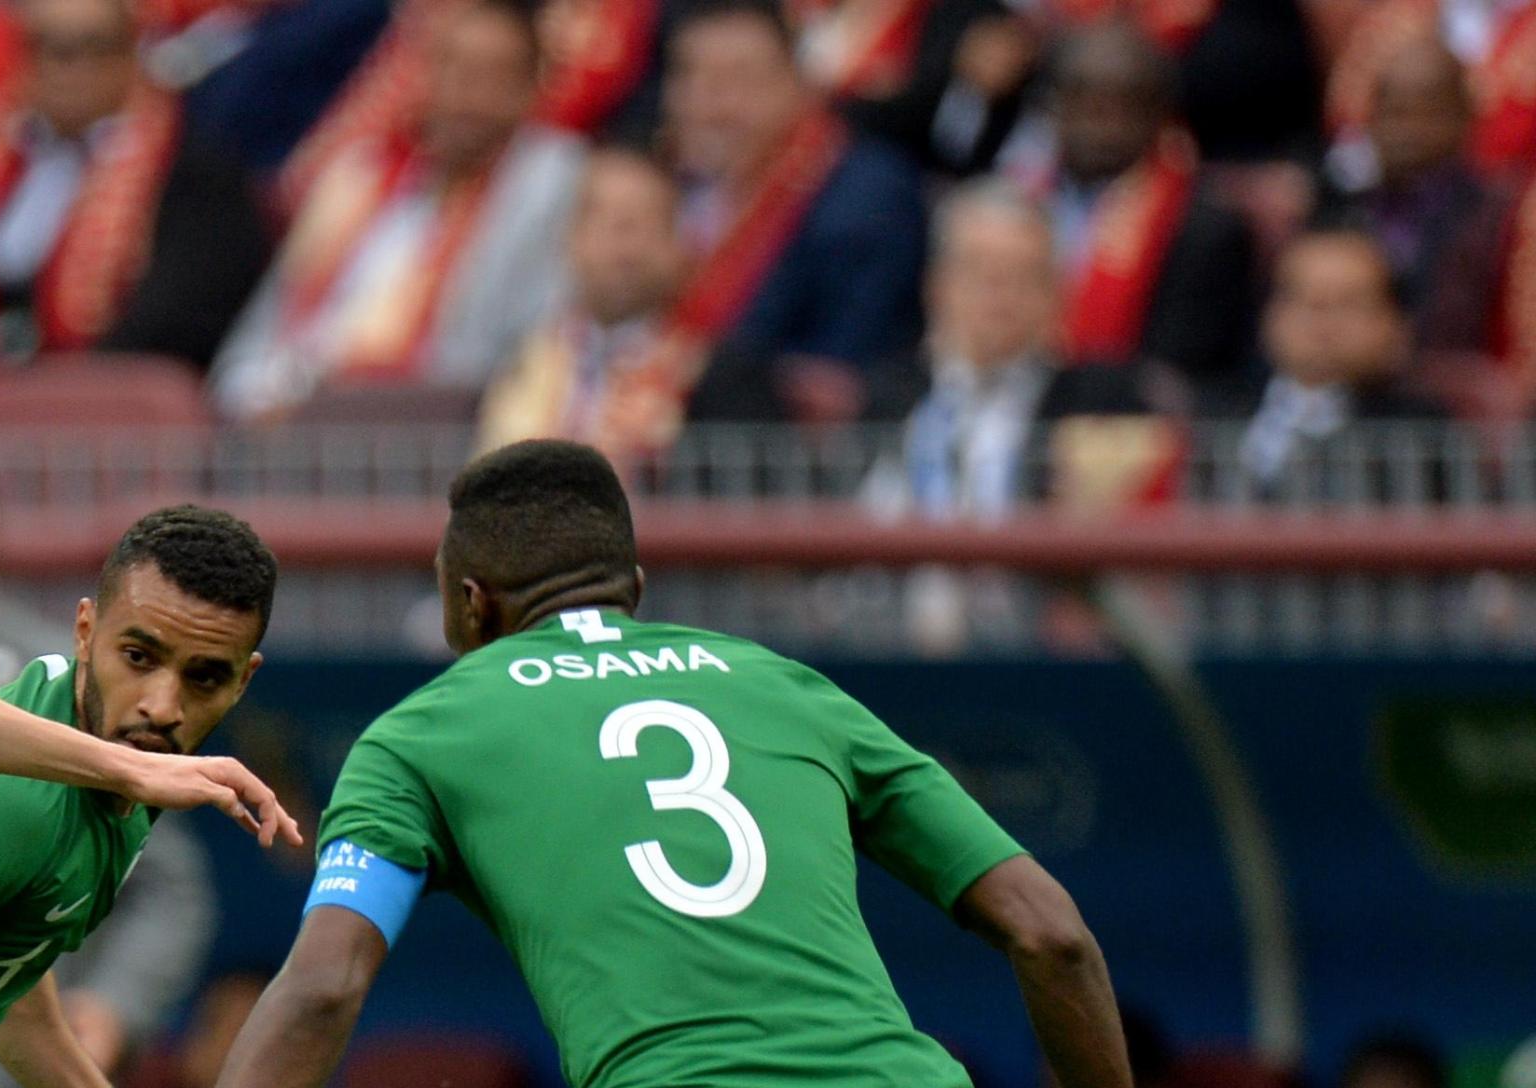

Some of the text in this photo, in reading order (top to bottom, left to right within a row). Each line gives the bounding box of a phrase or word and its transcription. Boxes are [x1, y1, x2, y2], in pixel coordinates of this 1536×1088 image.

[508, 644, 731, 687] OSAMA
[599, 699, 767, 917] 3
[316, 877, 357, 894] FIFA
